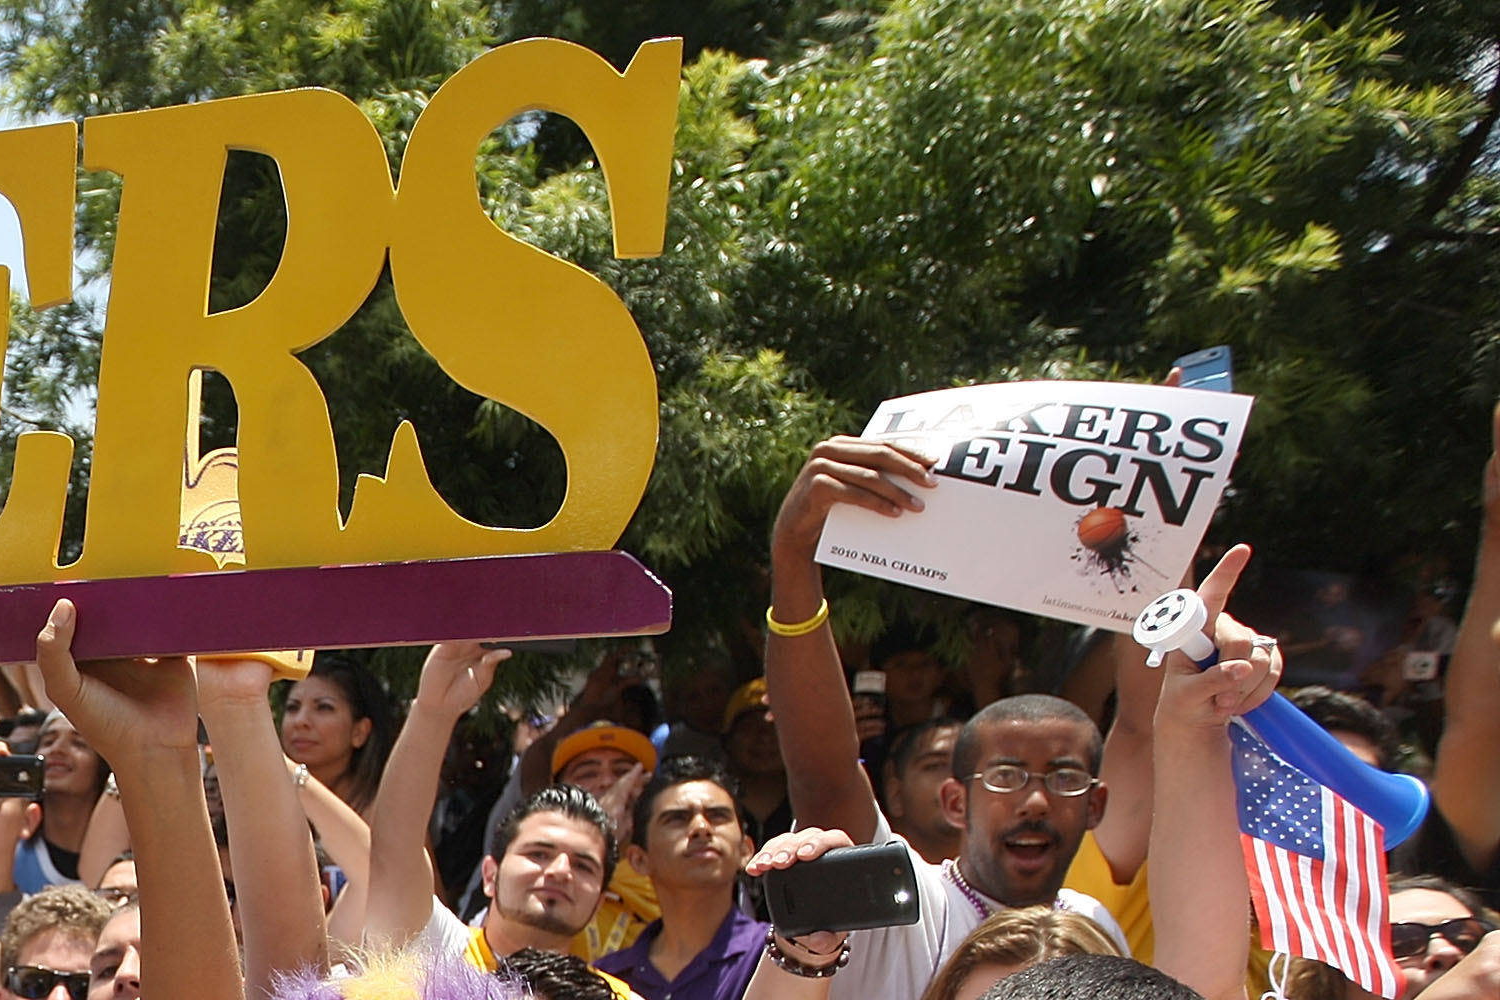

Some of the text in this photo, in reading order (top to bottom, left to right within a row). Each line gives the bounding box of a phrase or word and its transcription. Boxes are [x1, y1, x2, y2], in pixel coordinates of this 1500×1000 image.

[877, 402, 1230, 464] LAKERS
[930, 435, 1215, 527] EIGN
[829, 545, 948, 582] 2010 NBA CHAMPS
